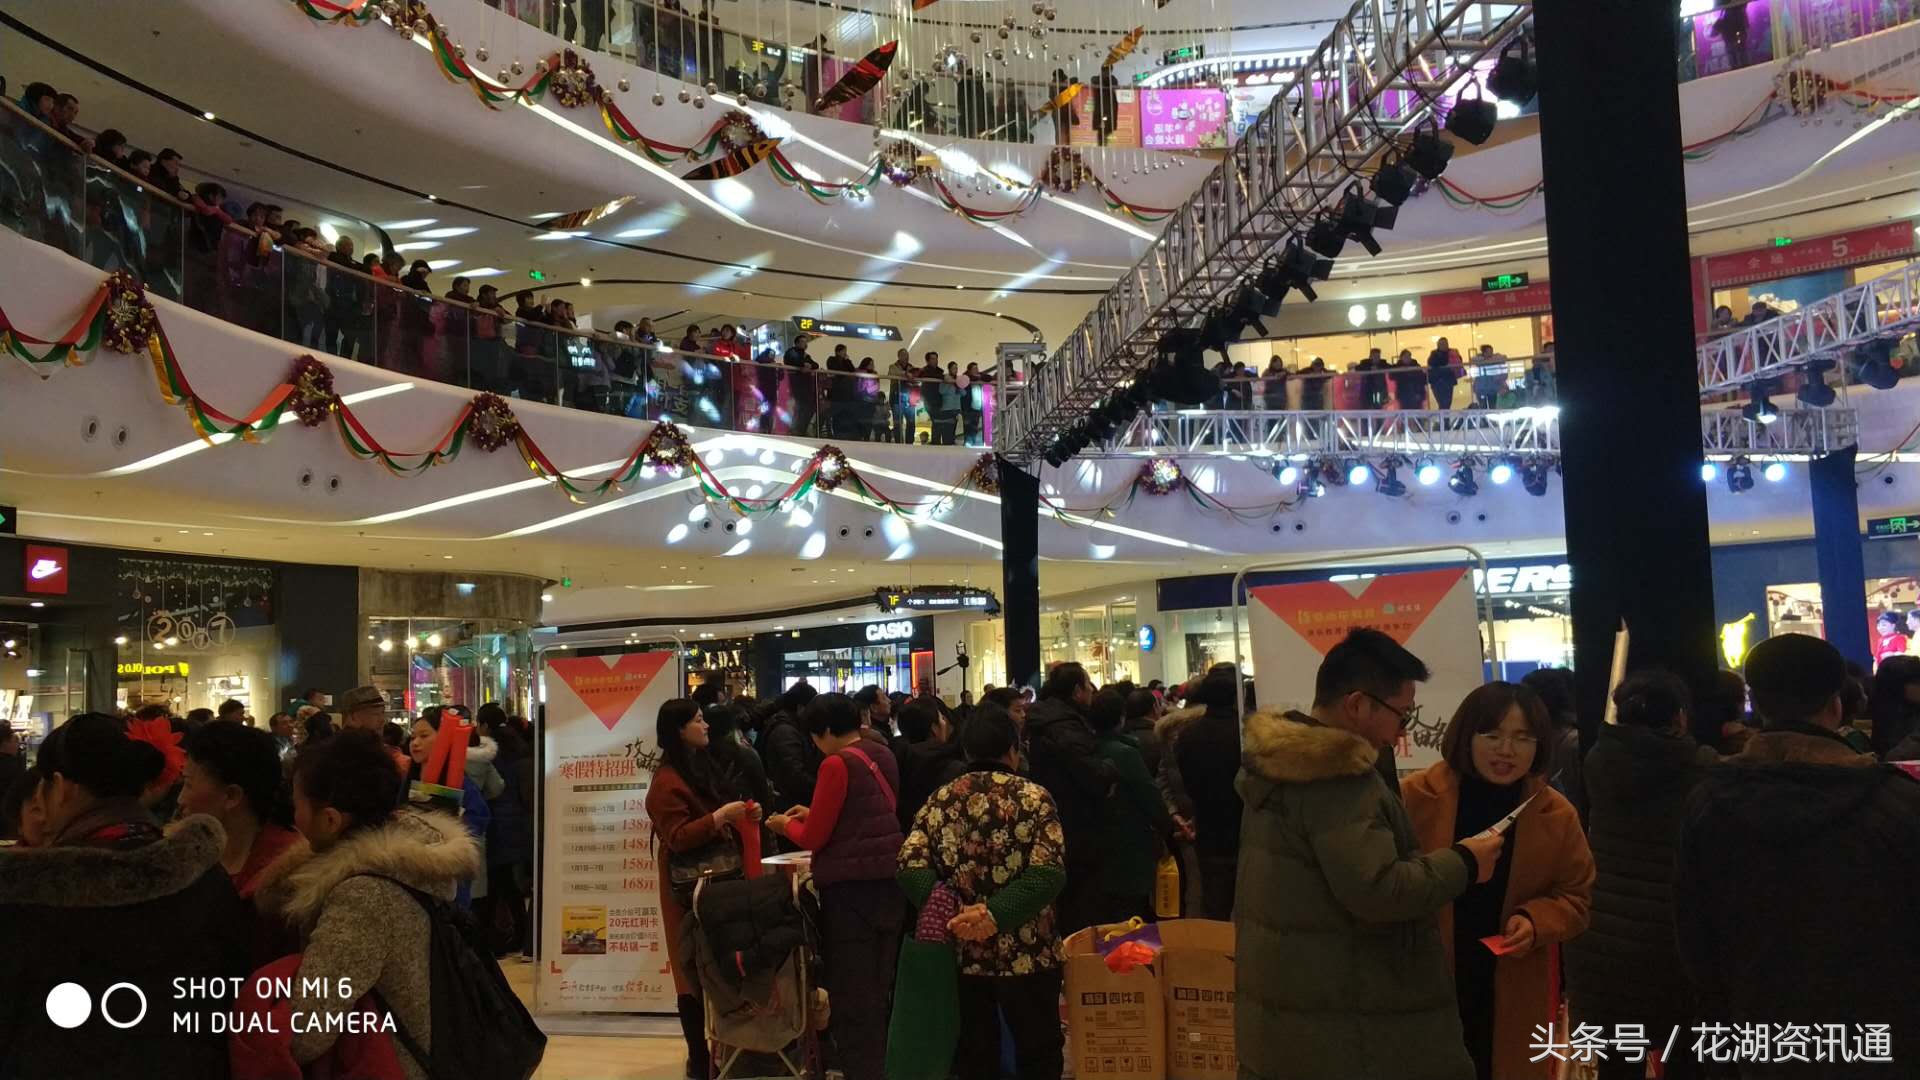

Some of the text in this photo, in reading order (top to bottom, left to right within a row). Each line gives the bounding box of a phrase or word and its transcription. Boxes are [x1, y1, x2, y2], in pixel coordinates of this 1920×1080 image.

[801, 319, 813, 329] 2F
[888, 595, 900, 606] 1F
[866, 620, 913, 641] CASIO
[559, 759, 637, 779] 寒假特招班
[609, 918, 659, 929] 20元红利卡
